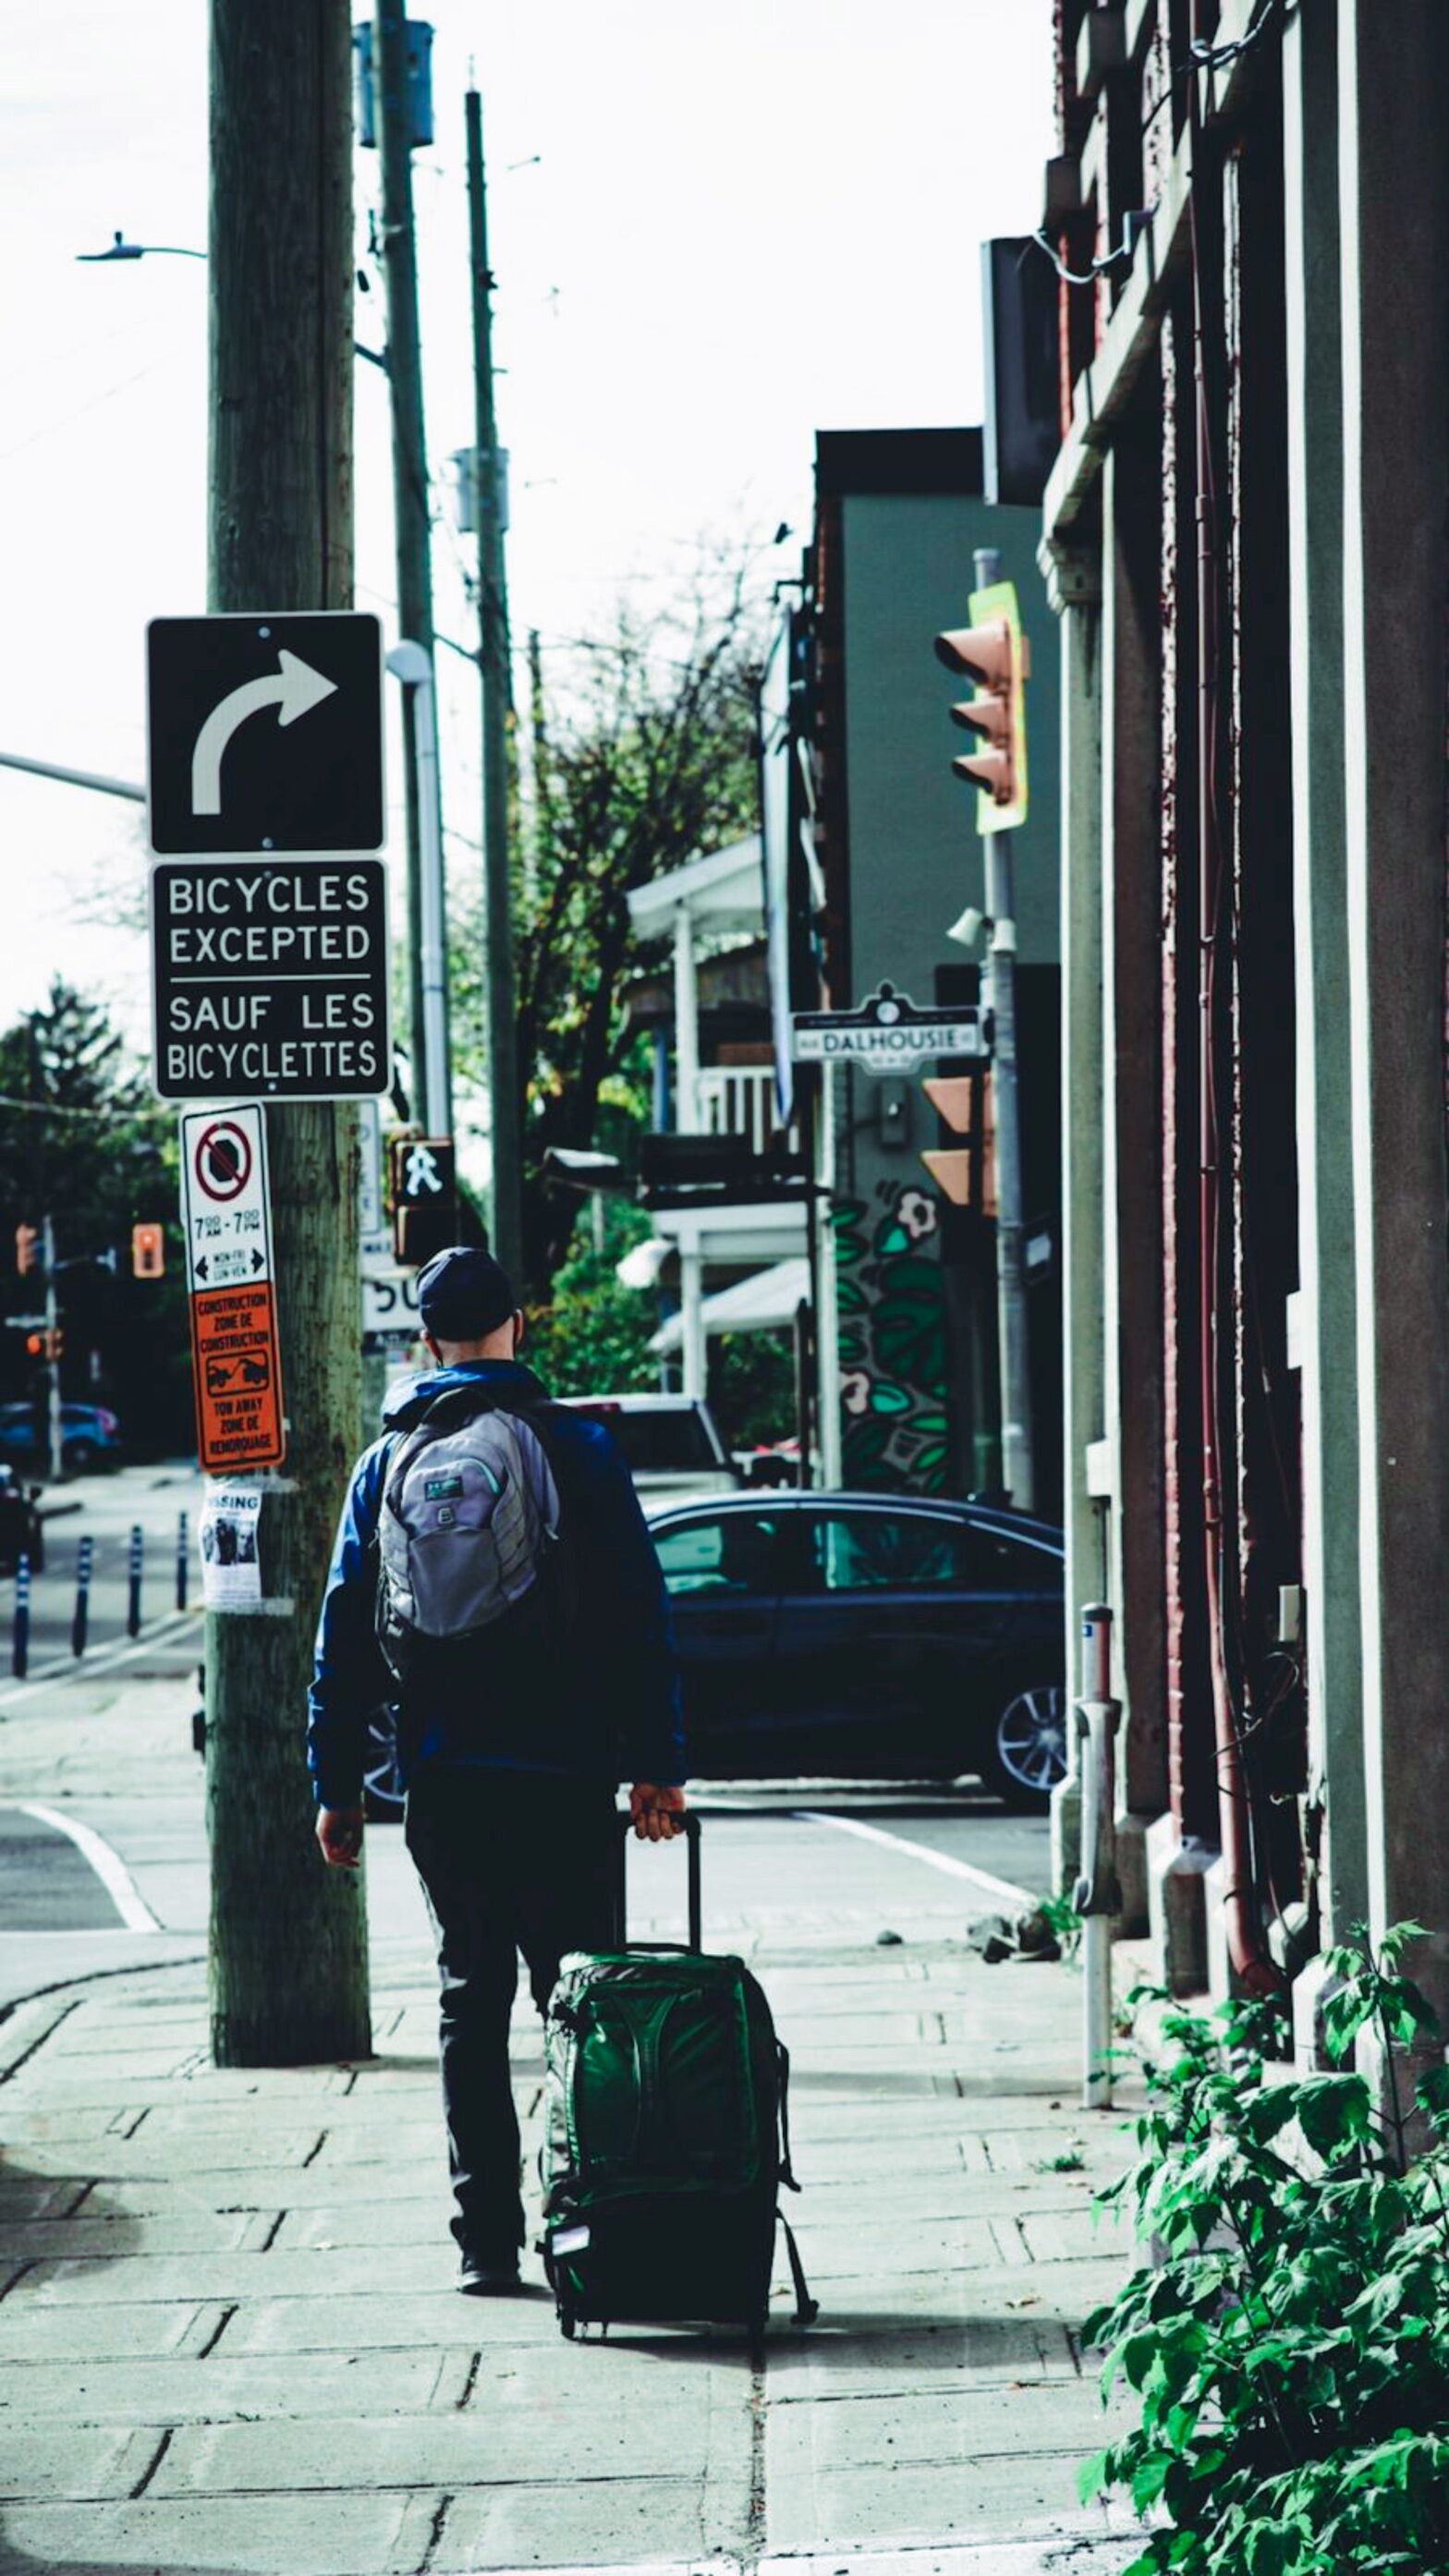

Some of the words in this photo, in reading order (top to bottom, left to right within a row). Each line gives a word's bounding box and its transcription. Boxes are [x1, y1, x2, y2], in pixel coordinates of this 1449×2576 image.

[169, 874, 370, 914] BICYCLES
[170, 925, 370, 963] EXCEPTED
[169, 995, 272, 1032] SAUF
[301, 992, 374, 1029] LES
[823, 1027, 957, 1052] DALHOUSIE
[167, 1039, 377, 1080] BICYCLETTES
[198, 1293, 267, 1317] CONSTRUCTION
[214, 1314, 238, 1332] ZONE
[240, 1312, 252, 1329] DE
[201, 1331, 269, 1353] CONSTRUCTION
[214, 1401, 234, 1416] TOW
[237, 1397, 262, 1414] AWAY
[221, 1416, 244, 1435] ZONE
[246, 1415, 259, 1431] DE
[210, 1433, 271, 1455] REMORQUAGE
